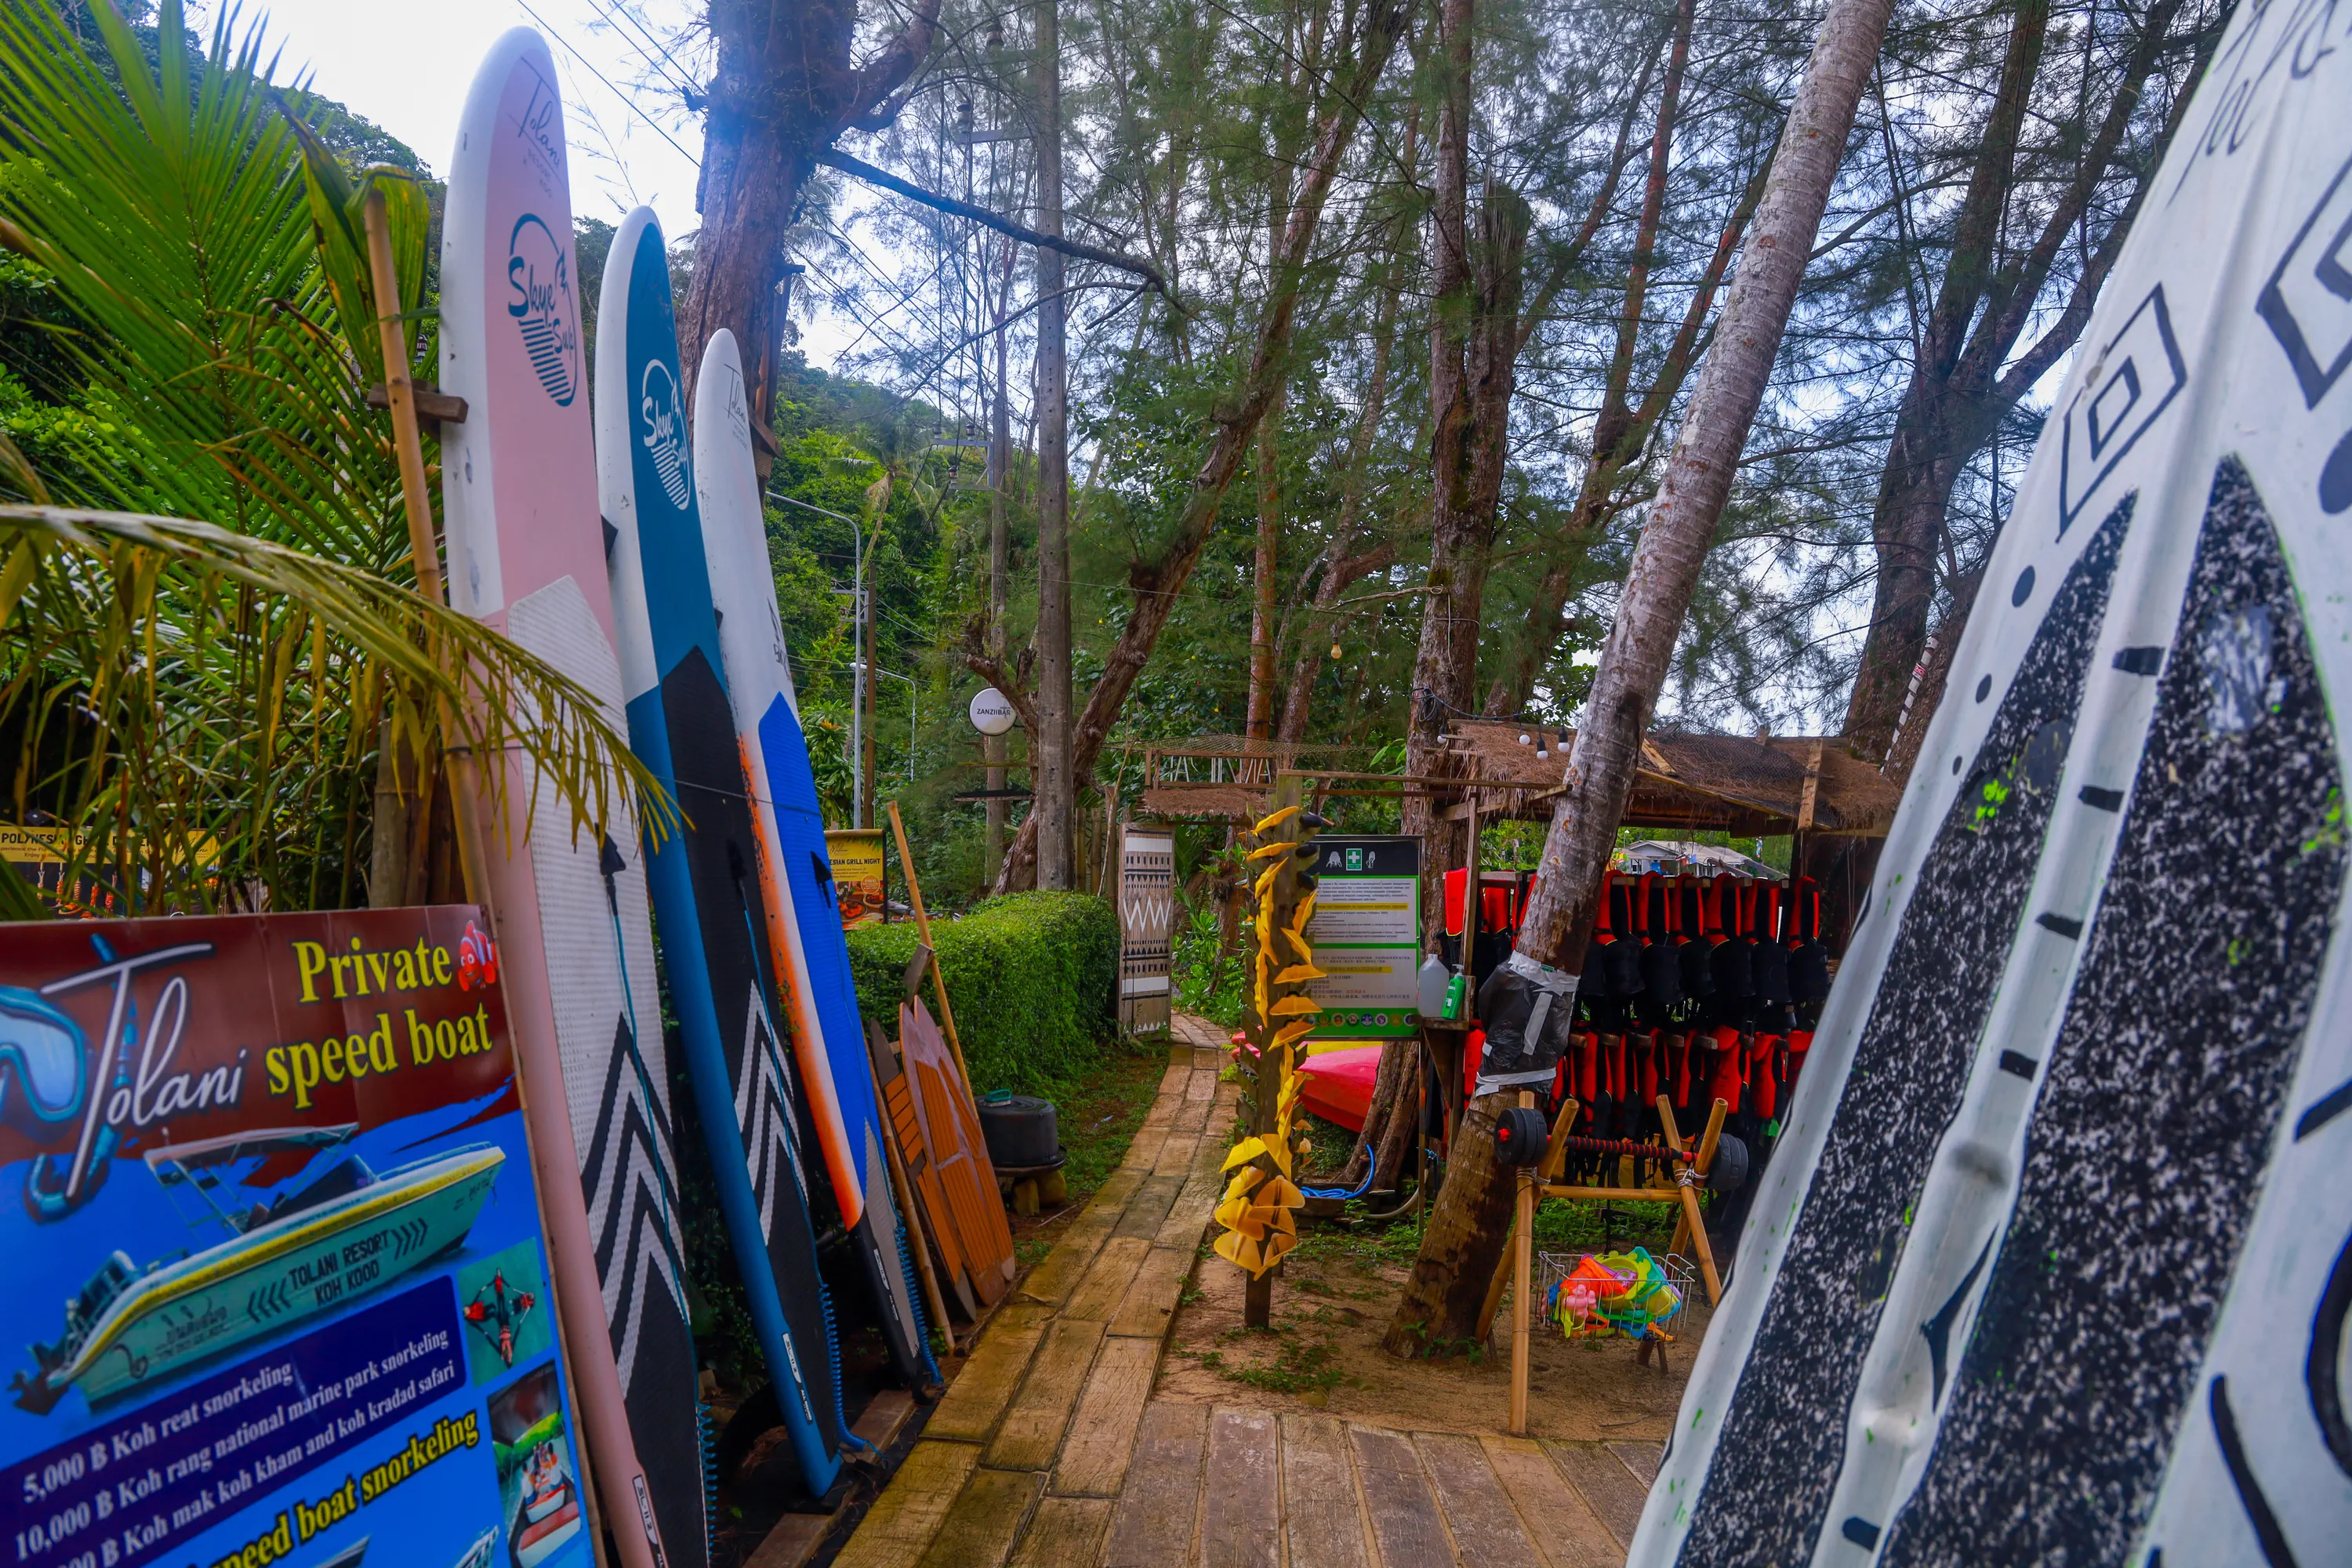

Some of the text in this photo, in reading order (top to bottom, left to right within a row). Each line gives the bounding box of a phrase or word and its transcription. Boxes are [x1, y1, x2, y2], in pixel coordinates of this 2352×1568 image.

[291, 936, 452, 1004] Private
[41, 943, 248, 1197] Tolani
[265, 1003, 493, 1109] speed boat
[288, 1229, 390, 1290] TOLANI RESORT
[314, 1260, 380, 1306] KOH KOOD
[16, 1501, 91, 1562] 10,000
[118, 1468, 163, 1508] Koh
[165, 1446, 214, 1483] rang
[214, 1406, 285, 1458] national
[288, 1382, 343, 1423] marine
[344, 1360, 380, 1399] park
[381, 1330, 450, 1374] snorkeling
[23, 1452, 85, 1503] 5,000
[111, 1421, 157, 1461] Koh
[160, 1403, 201, 1438] reat
[202, 1362, 294, 1417] snorkeling
[122, 1515, 169, 1556] Koh
[172, 1490, 217, 1530] mak
[217, 1469, 253, 1504] koh
[255, 1445, 304, 1483] kham
[305, 1423, 336, 1456] and
[337, 1409, 367, 1438] koh
[368, 1379, 417, 1422] kradad
[418, 1359, 456, 1395] safari
[294, 1474, 358, 1544] boat
[361, 1411, 479, 1503] snorkeling
